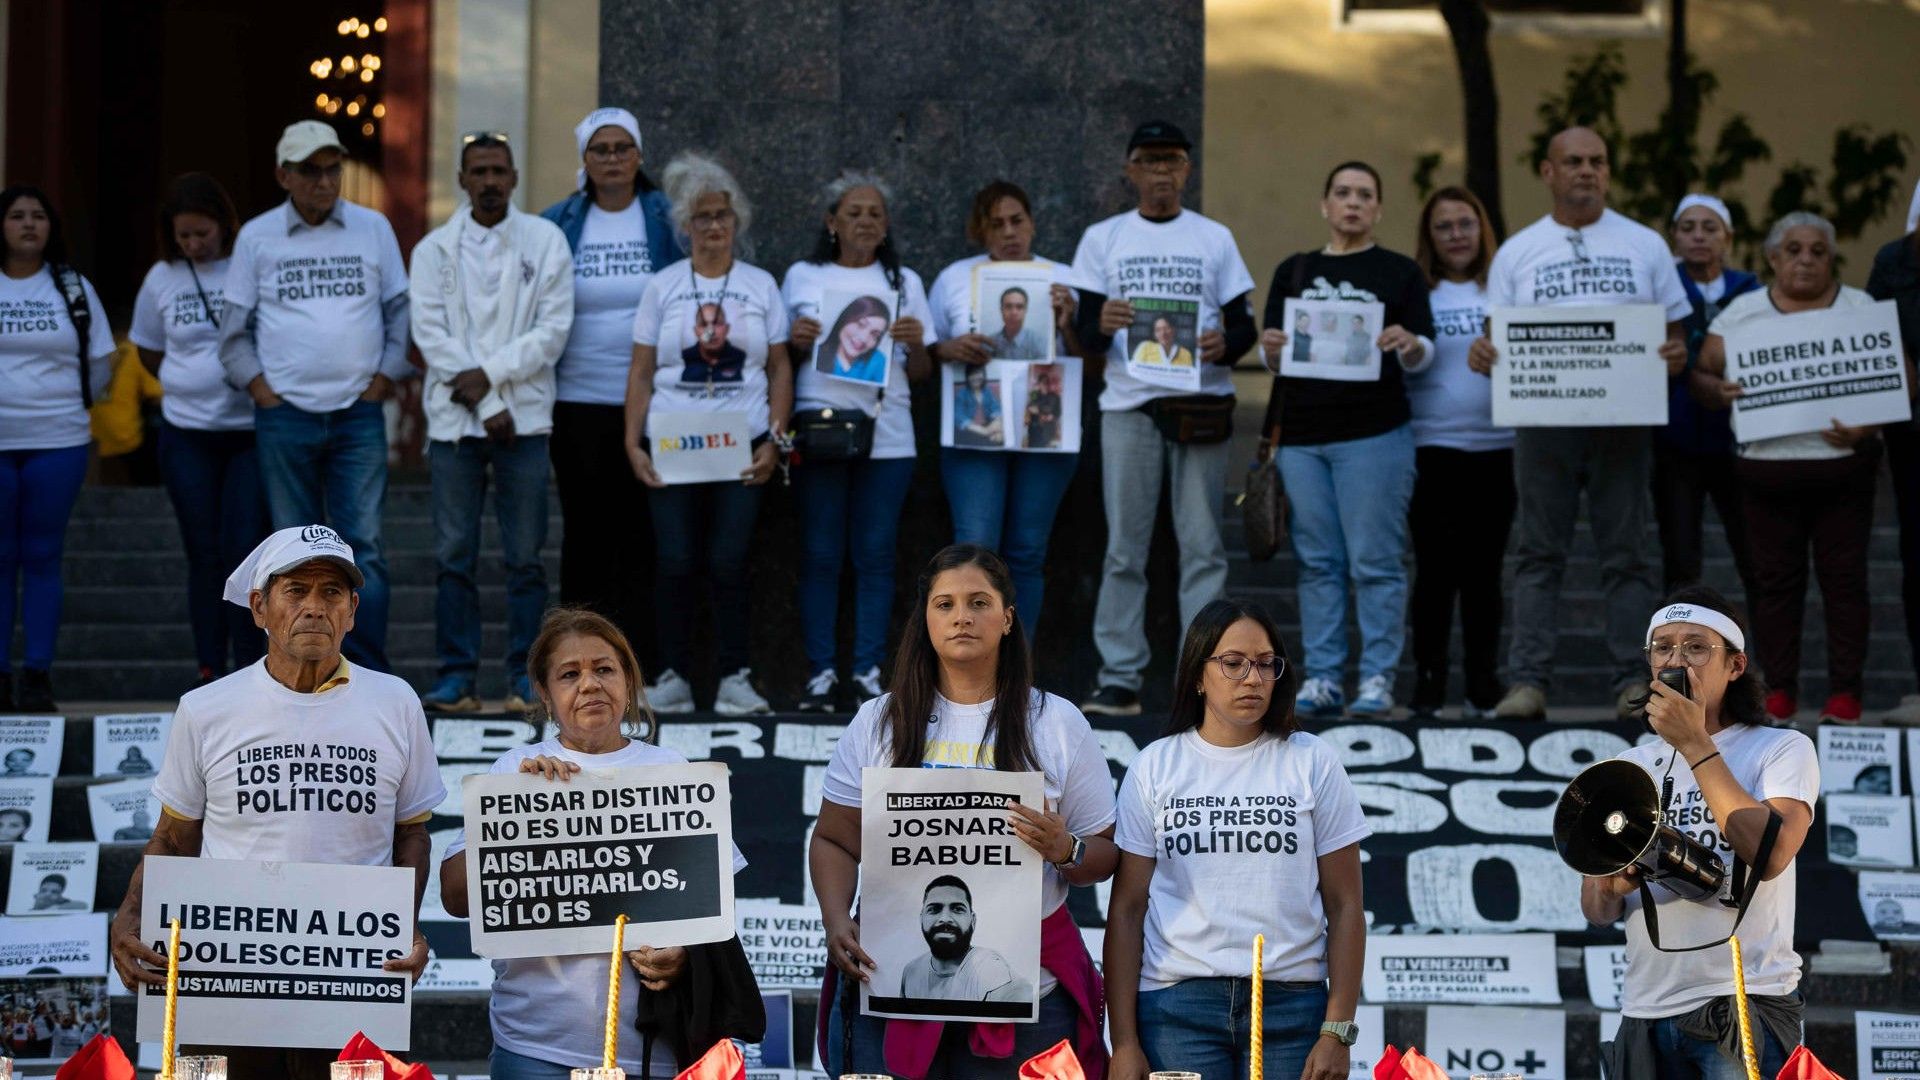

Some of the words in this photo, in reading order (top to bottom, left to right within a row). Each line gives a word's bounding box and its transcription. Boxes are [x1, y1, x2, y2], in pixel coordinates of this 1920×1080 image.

[277, 270, 304, 285] LOS
[308, 266, 364, 281] PRESOS
[1118, 268, 1144, 280] LOS
[1150, 267, 1204, 279] PRESOS
[1535, 271, 1564, 285] LOS
[1571, 266, 1633, 279] PRESOS
[277, 280, 366, 301] POLÍTICOS
[1534, 278, 1637, 302] POLÍTICOS
[1509, 328, 1527, 341] EN
[1529, 327, 1612, 341] VENEZUELA,
[1510, 346, 1526, 356] LA
[1529, 342, 1646, 356] REVICTIMIZACIÓN
[1737, 339, 1825, 369] LIBEREN
[1832, 338, 1846, 354] A
[1851, 331, 1892, 352] LOS
[1510, 361, 1517, 370] Y
[1520, 360, 1538, 370] LA
[1541, 359, 1612, 370] INJUSTICIA
[1738, 355, 1898, 389] ADOLESCENTES
[1510, 375, 1525, 384] SE
[1529, 375, 1557, 384] HAN
[1829, 375, 1901, 397] DETENIDOS
[1510, 388, 1607, 400] NORMALIZADO
[237, 743, 305, 764] LIBEREN
[310, 743, 322, 758] A
[326, 744, 377, 763] TODOS
[237, 764, 281, 787] LOS
[289, 762, 377, 787] PRESOS
[237, 783, 377, 815] POLÍTICOS
[480, 790, 585, 815] PENSAR
[592, 783, 716, 809] DISTINTO
[888, 795, 966, 808] LIBERTAD
[971, 795, 1014, 807] PARA
[1164, 796, 1225, 811] LIBEREN
[1230, 796, 1241, 807] A
[1245, 795, 1297, 808] TODOS
[1672, 793, 1682, 805] A
[481, 820, 520, 842] NO
[527, 818, 560, 839] ES
[566, 815, 603, 837] UN
[611, 809, 713, 835] DELITO.
[1164, 810, 1201, 832] LOS
[1209, 809, 1297, 827] PRESOS
[1165, 826, 1298, 859] POLÍTICOS
[482, 845, 631, 874] AISLARLOS
[635, 844, 654, 865] Y
[891, 845, 1022, 866] BABUEL
[483, 869, 687, 900] TORTURARLOS,
[160, 903, 298, 934] LIBEREN
[306, 910, 329, 935] A
[338, 911, 401, 938] LOS
[484, 900, 510, 927] SÍ
[517, 903, 551, 926] LO
[558, 900, 591, 922] ES
[744, 917, 768, 930] EN
[742, 935, 765, 947] SE
[38, 953, 90, 963] ARMAS
[1385, 958, 1402, 970] EN
[1406, 957, 1505, 971] VENEZUELA
[149, 976, 290, 994] USTAMENTE
[294, 980, 402, 998] DETENIDOS
[1386, 973, 1405, 982] SE
[1410, 973, 1487, 983] PERSIGUE
[1436, 985, 1530, 994] FAMILIARES
[1447, 1050, 1505, 1072] NO
